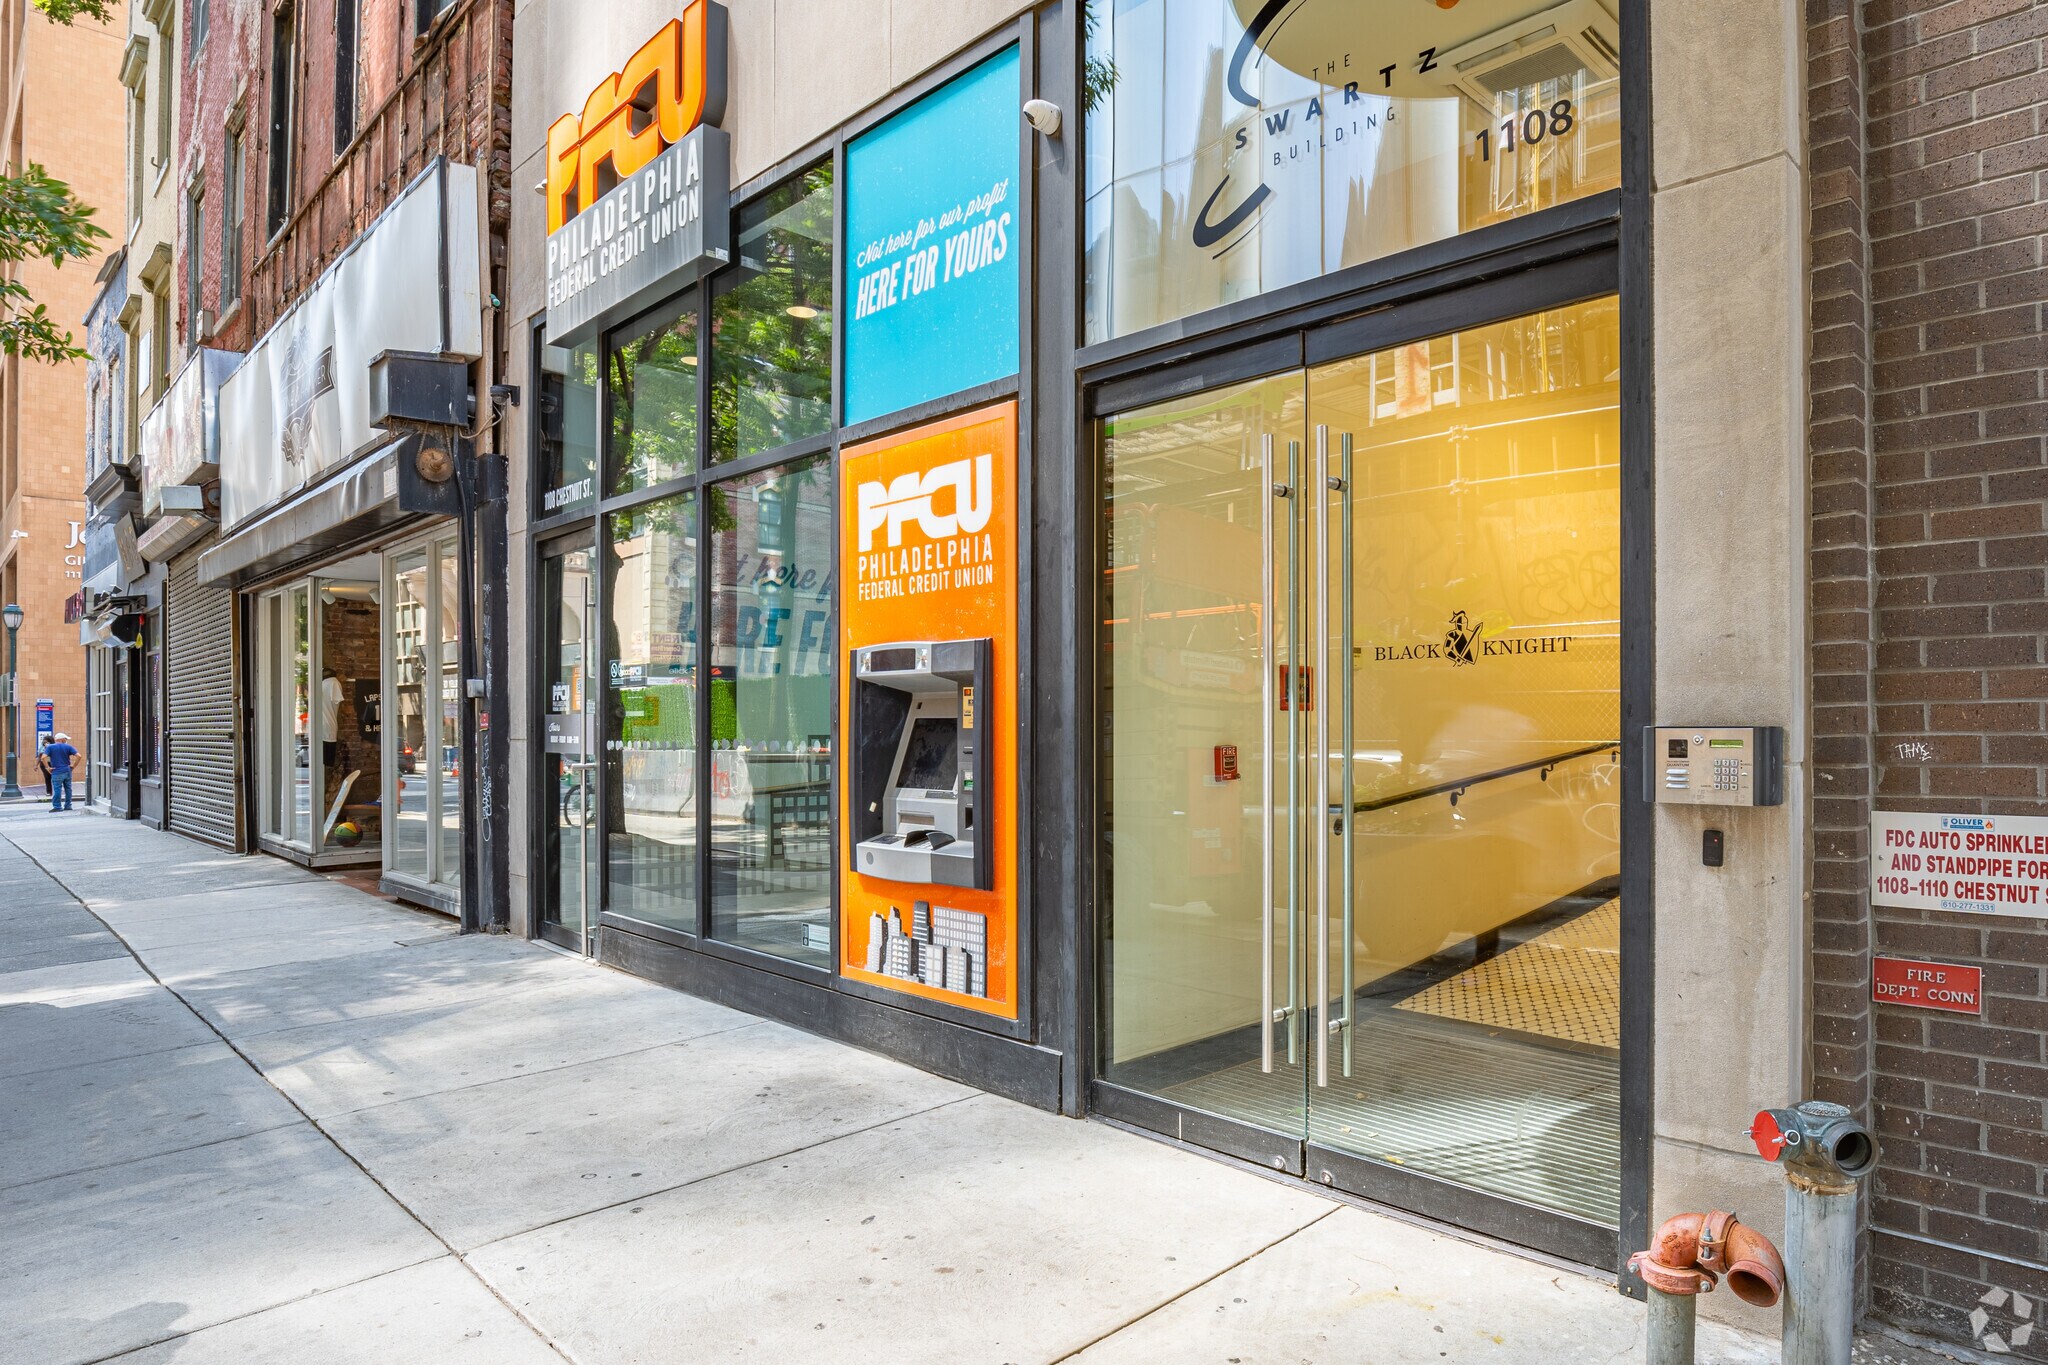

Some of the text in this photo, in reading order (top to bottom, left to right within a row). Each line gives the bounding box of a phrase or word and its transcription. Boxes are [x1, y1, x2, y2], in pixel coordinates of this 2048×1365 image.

[1312, 53, 1351, 82] THE
[1235, 46, 1439, 150] SWARTZ
[1272, 107, 1396, 166] BUILDING
[1476, 100, 1576, 162] 1108
[549, 137, 700, 280] PHILADELPHIA
[856, 177, 1009, 269] Not here for our profit
[549, 186, 700, 312] FEDERAL CREDIT UNION
[855, 211, 1012, 321] HERE FOR YOURS
[556, 480, 583, 507] CHESTNUT
[582, 477, 593, 498] ST.
[857, 453, 993, 553] PFCU
[858, 533, 993, 581] PHILADELPHIA
[858, 578, 905, 602] FEDERAL
[908, 570, 950, 595] CREDIT
[954, 563, 993, 589] UNION
[1374, 636, 1573, 662] BLACK KNIGHT
[1222, 747, 1236, 755] FIRE
[1885, 829, 2048, 855] FDC AUTO SPRINKLE
[1891, 853, 2048, 880] AND STANDPIPE FOR
[1877, 876, 1949, 898] 1108-1110
[1954, 880, 2040, 905] CHESTNUT
[1942, 901, 1994, 912] 610-277-1331
[1907, 968, 1947, 984] FIRE
[1876, 982, 1978, 1006] DEPT. CONN.
